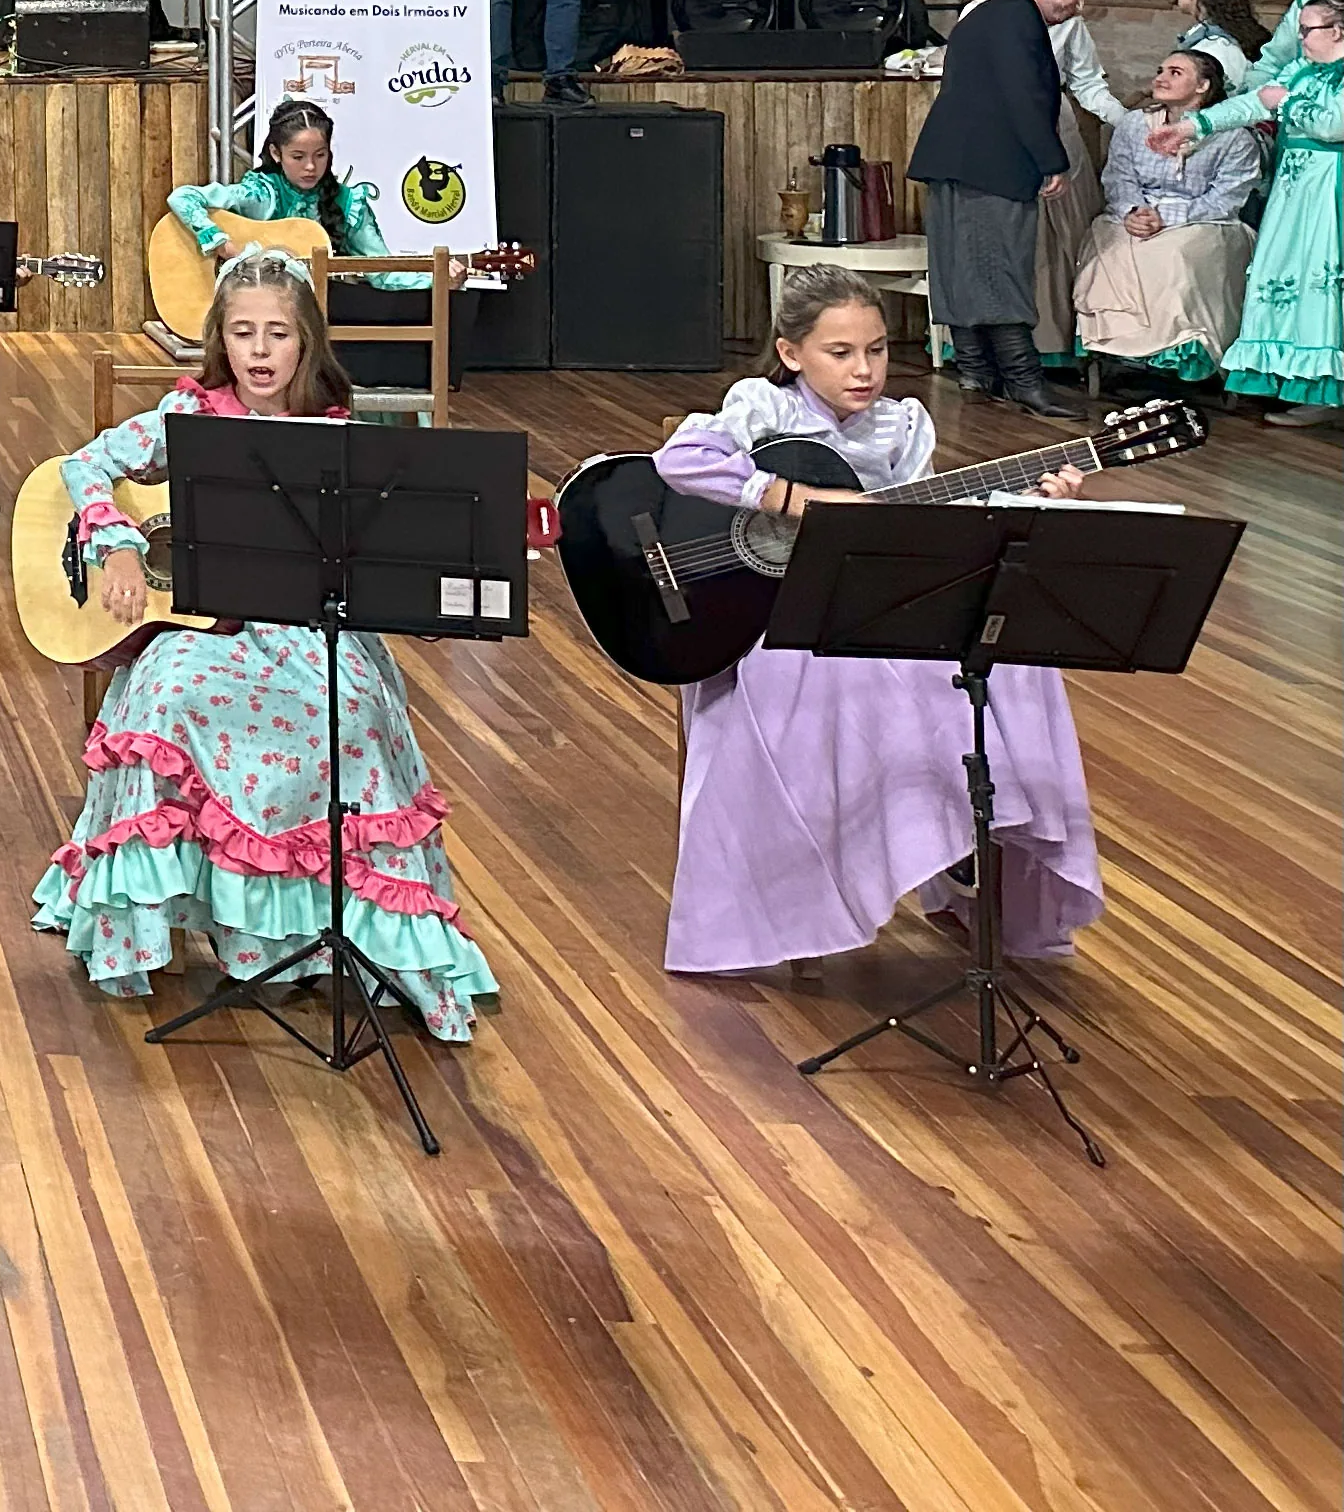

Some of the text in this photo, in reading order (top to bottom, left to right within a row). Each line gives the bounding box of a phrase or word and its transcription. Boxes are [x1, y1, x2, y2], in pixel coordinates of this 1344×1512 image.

[279, 4, 468, 18] Musicando em Dois Irmãos IV
[400, 43, 447, 61] HERVAL EM
[388, 61, 472, 93] cordas
[421, 207, 447, 218] Marcial
